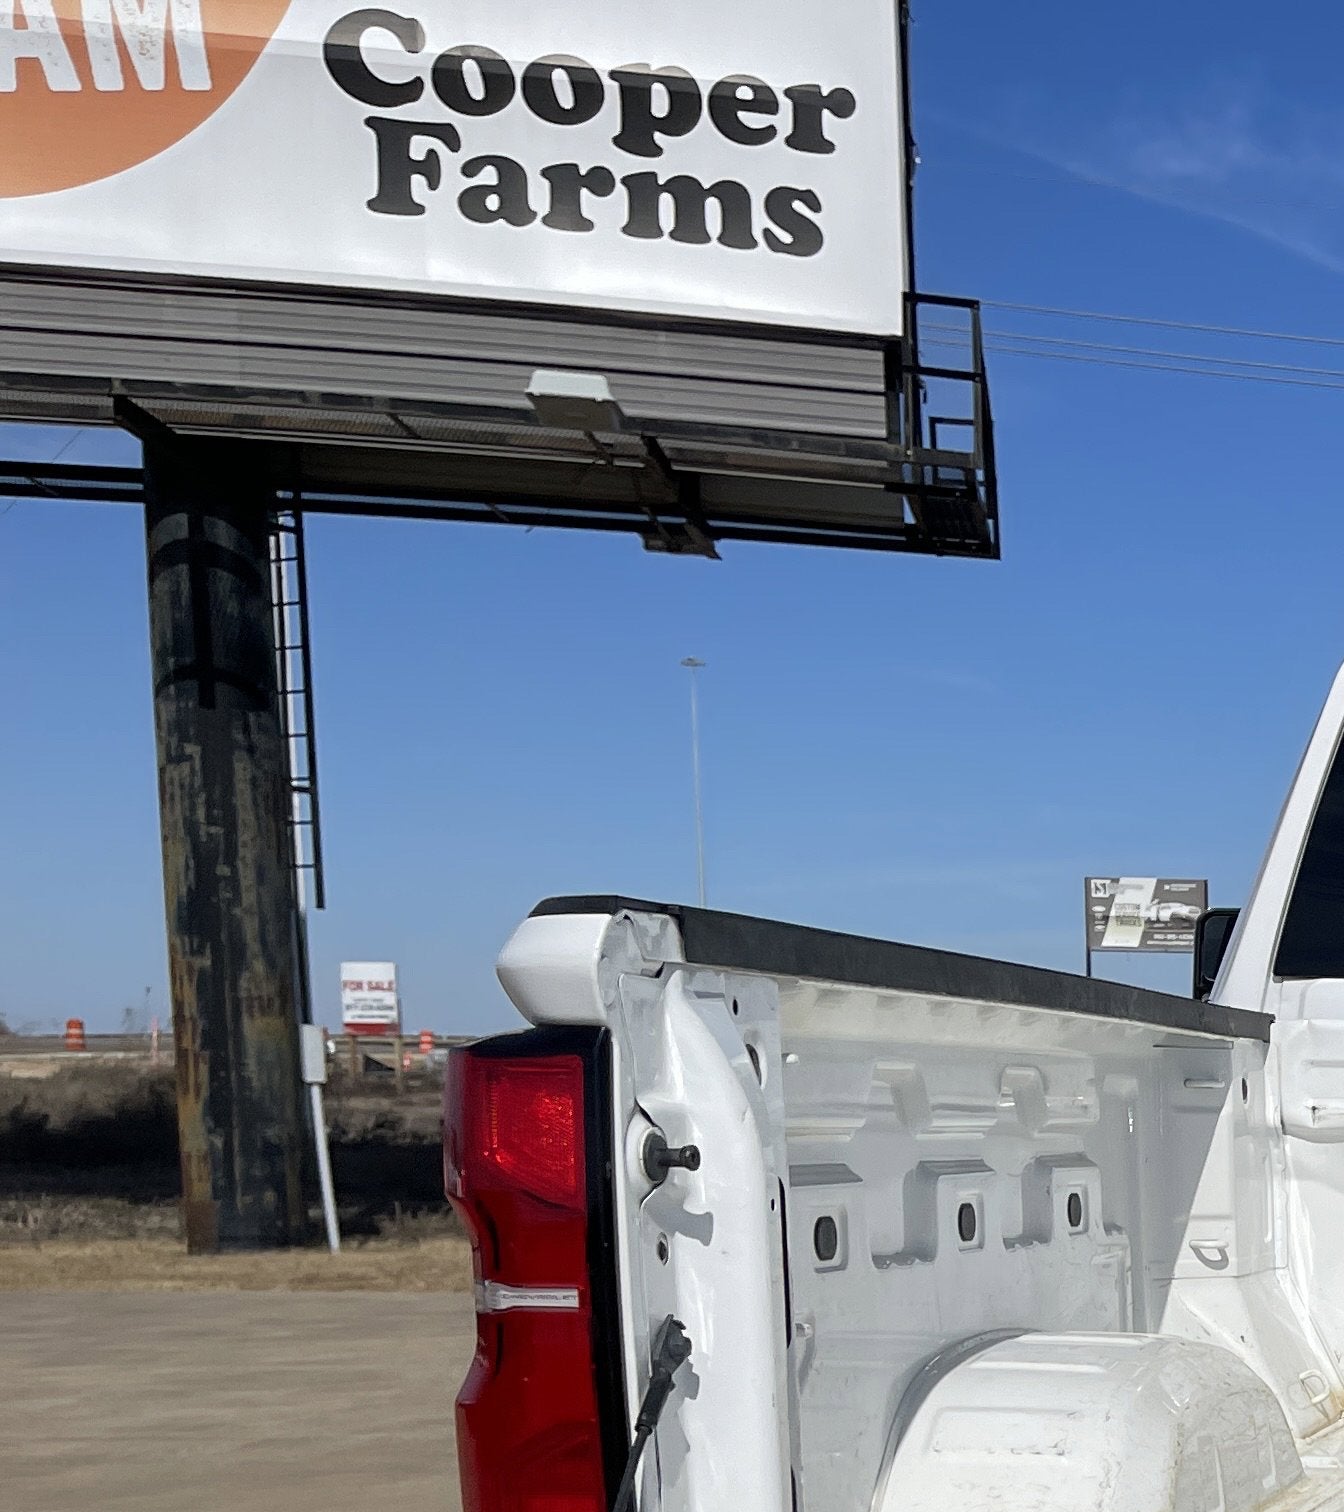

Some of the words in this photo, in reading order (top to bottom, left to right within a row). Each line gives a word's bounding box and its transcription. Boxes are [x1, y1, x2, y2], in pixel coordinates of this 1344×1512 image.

[322, 7, 857, 158] Cooper
[363, 115, 824, 258] Farms
[368, 980, 394, 991] SALE
